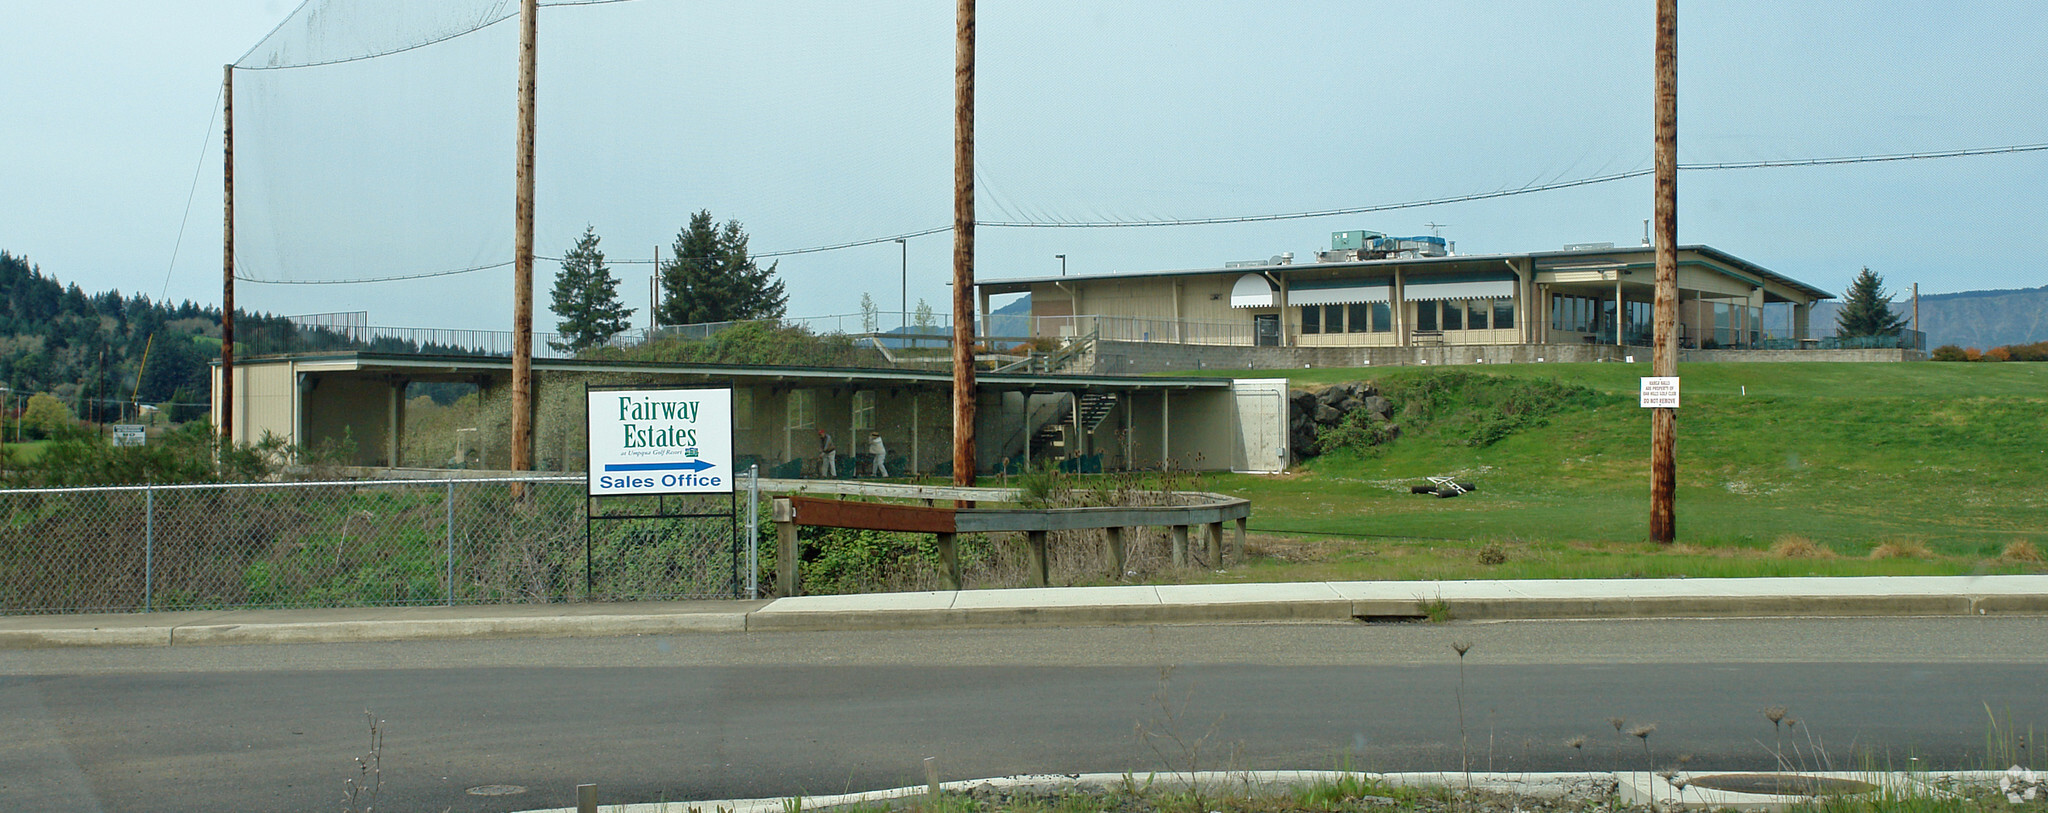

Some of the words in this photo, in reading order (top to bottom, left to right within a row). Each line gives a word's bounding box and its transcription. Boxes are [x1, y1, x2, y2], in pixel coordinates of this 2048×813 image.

[618, 396, 700, 424] Fairway
[623, 424, 697, 448] Estates
[600, 476, 654, 488] Sales
[662, 474, 722, 487] Office
